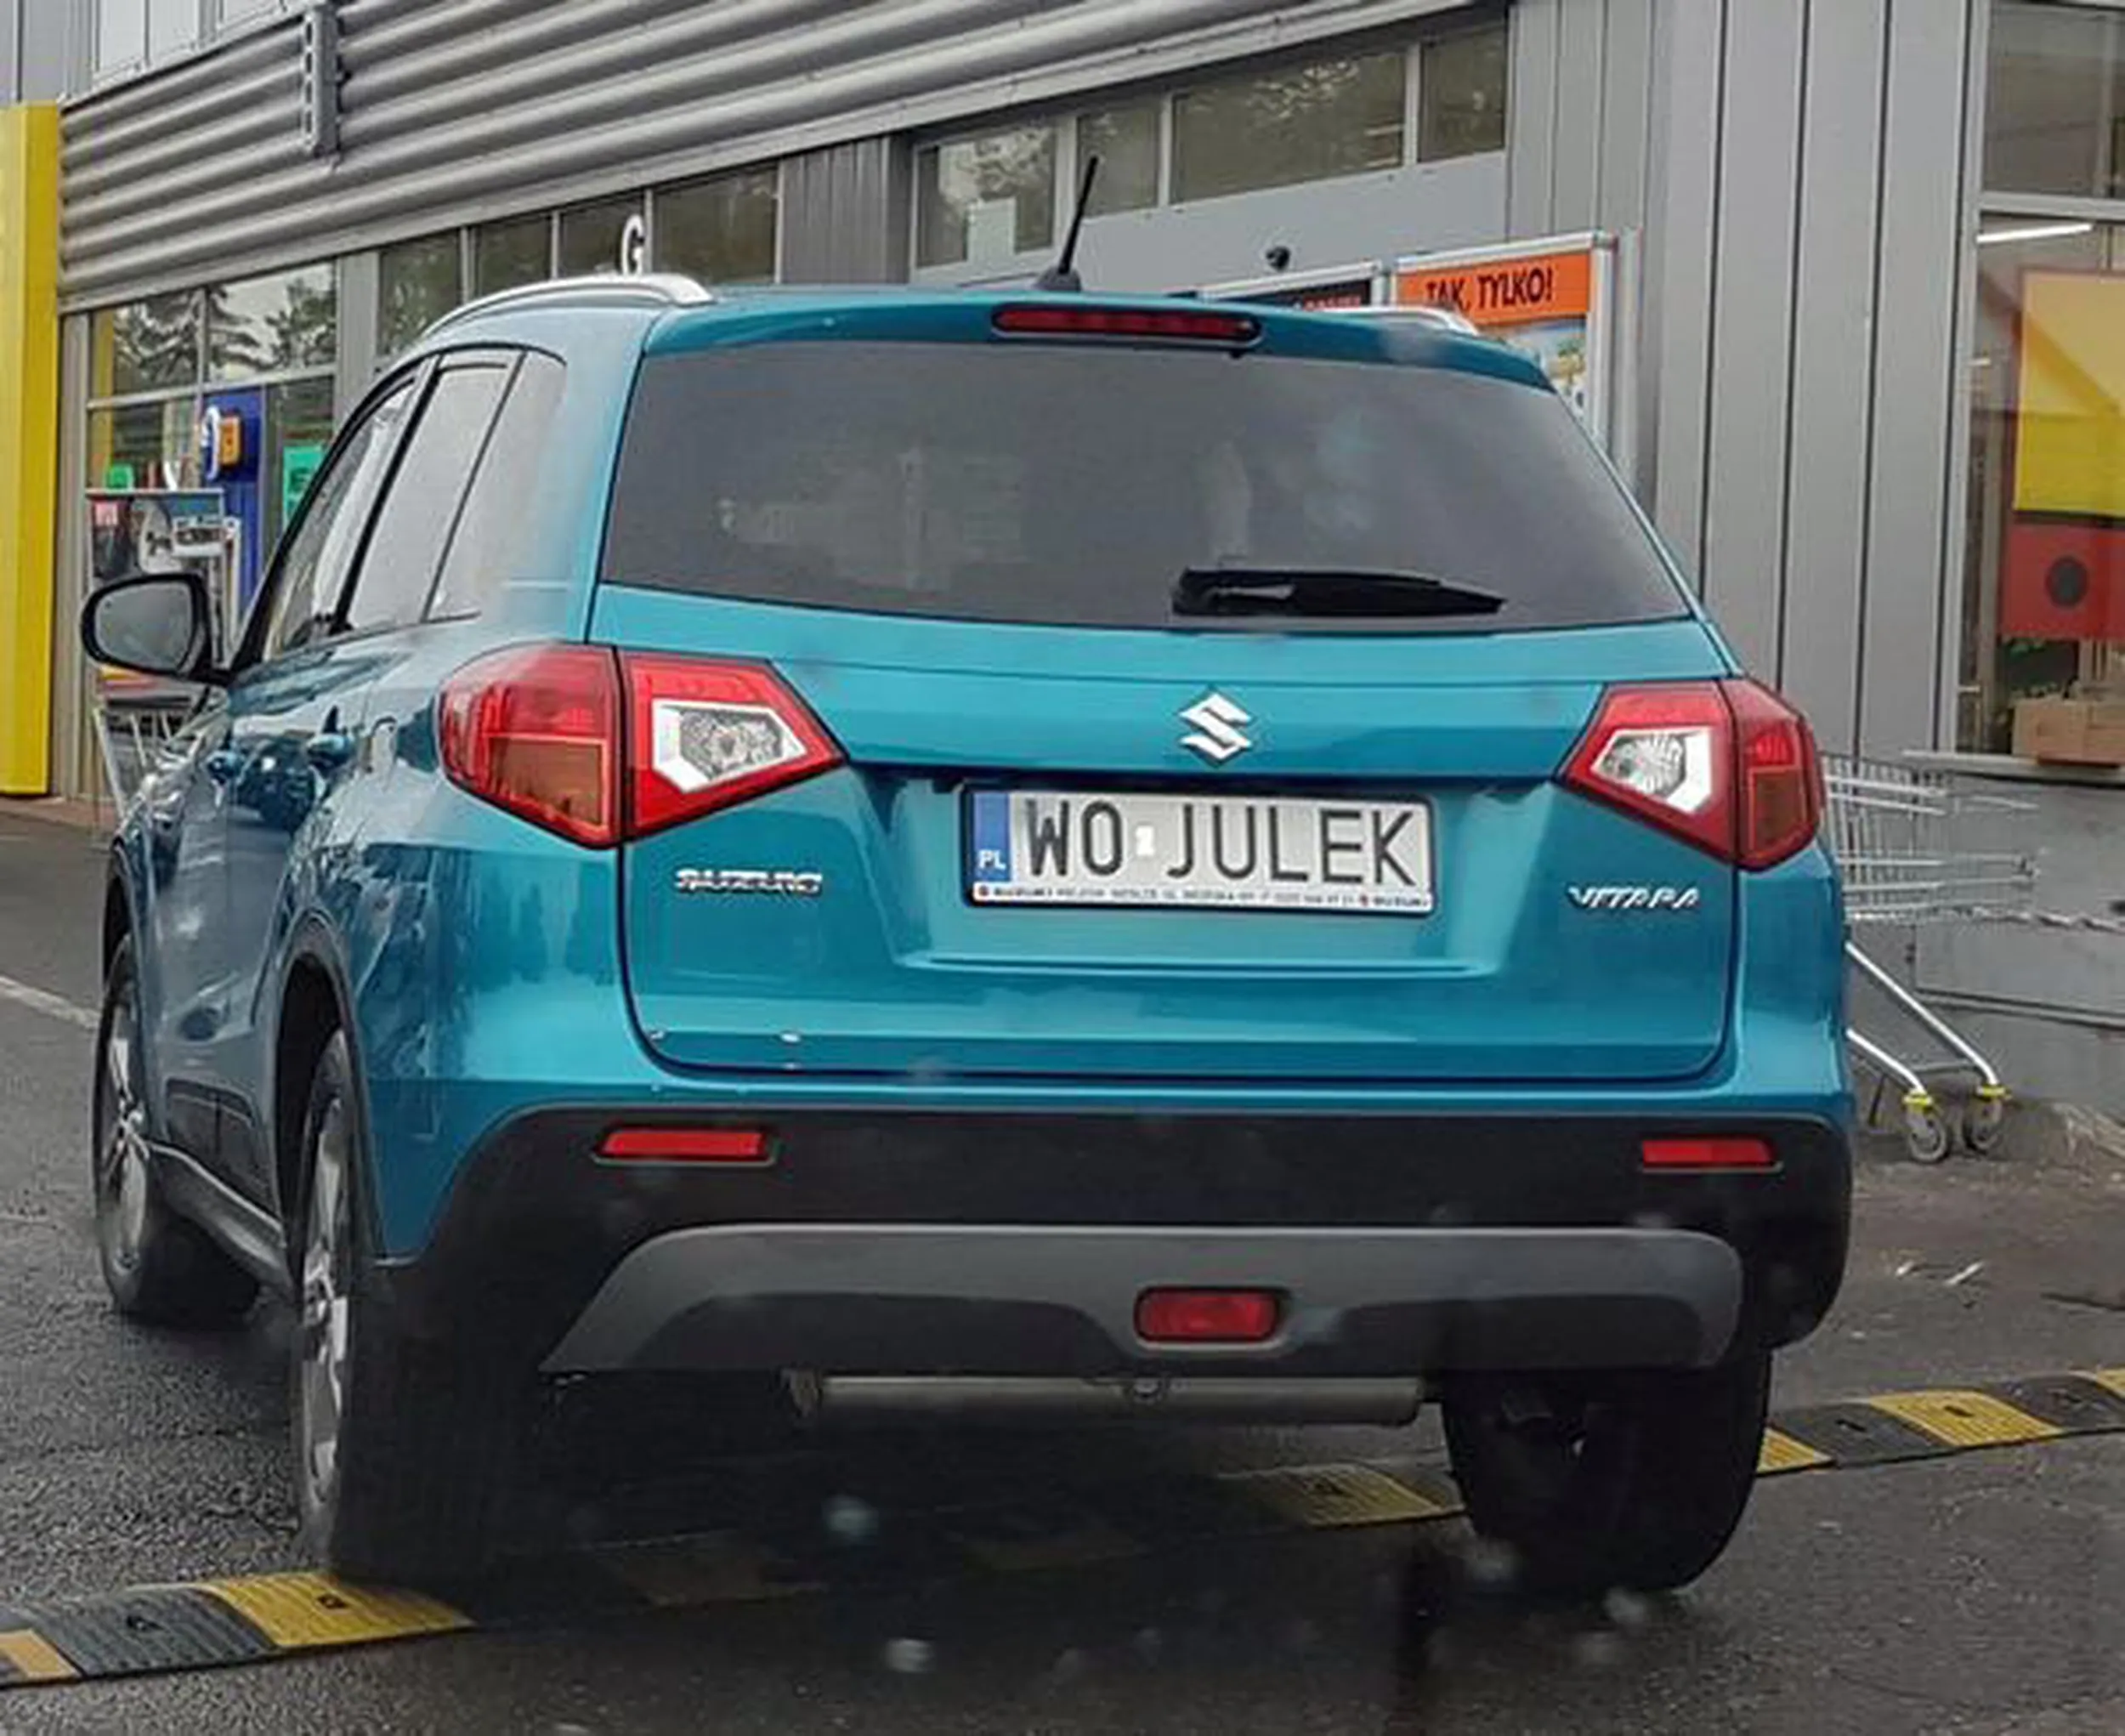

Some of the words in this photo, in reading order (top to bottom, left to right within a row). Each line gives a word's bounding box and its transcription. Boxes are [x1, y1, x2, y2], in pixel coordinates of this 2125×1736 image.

[1477, 266, 1553, 309] TYLKO!
[1025, 799, 1122, 877] WO
[1167, 804, 1415, 886] JULEK
[978, 850, 1006, 870] PL
[1568, 887, 1699, 909] VITARA
